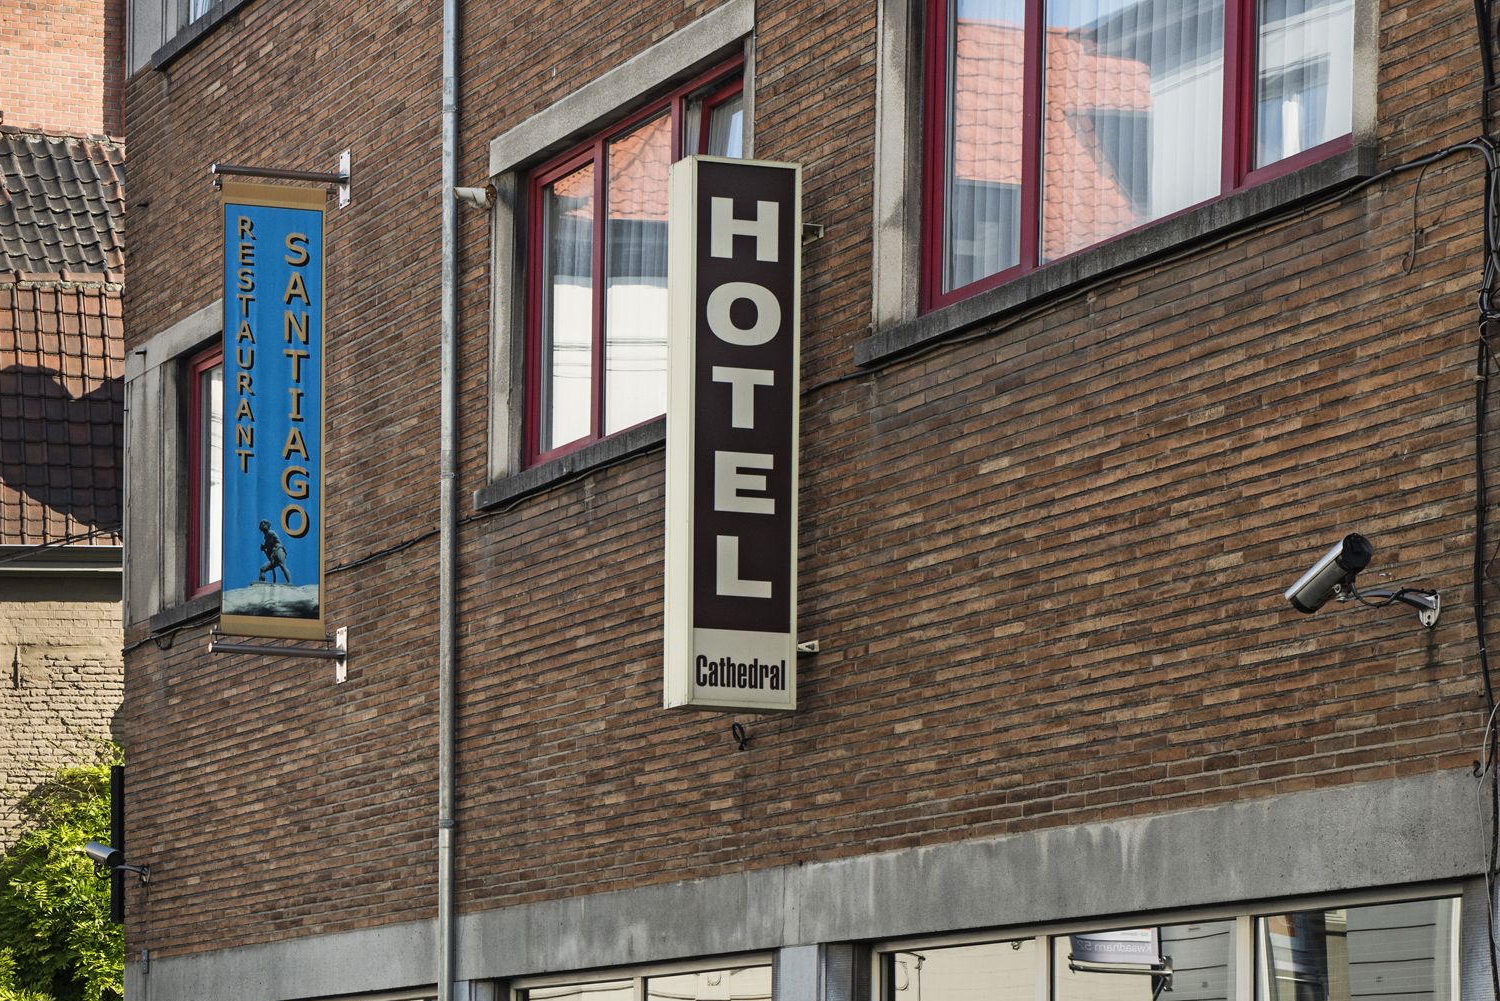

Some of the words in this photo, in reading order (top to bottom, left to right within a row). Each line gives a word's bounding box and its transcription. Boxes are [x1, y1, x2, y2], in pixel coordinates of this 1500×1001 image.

[236, 215, 256, 475] RESTAURANT
[280, 231, 311, 540] SANTIAGO
[706, 196, 782, 599] HOTEL
[695, 654, 788, 693] Cathedral
